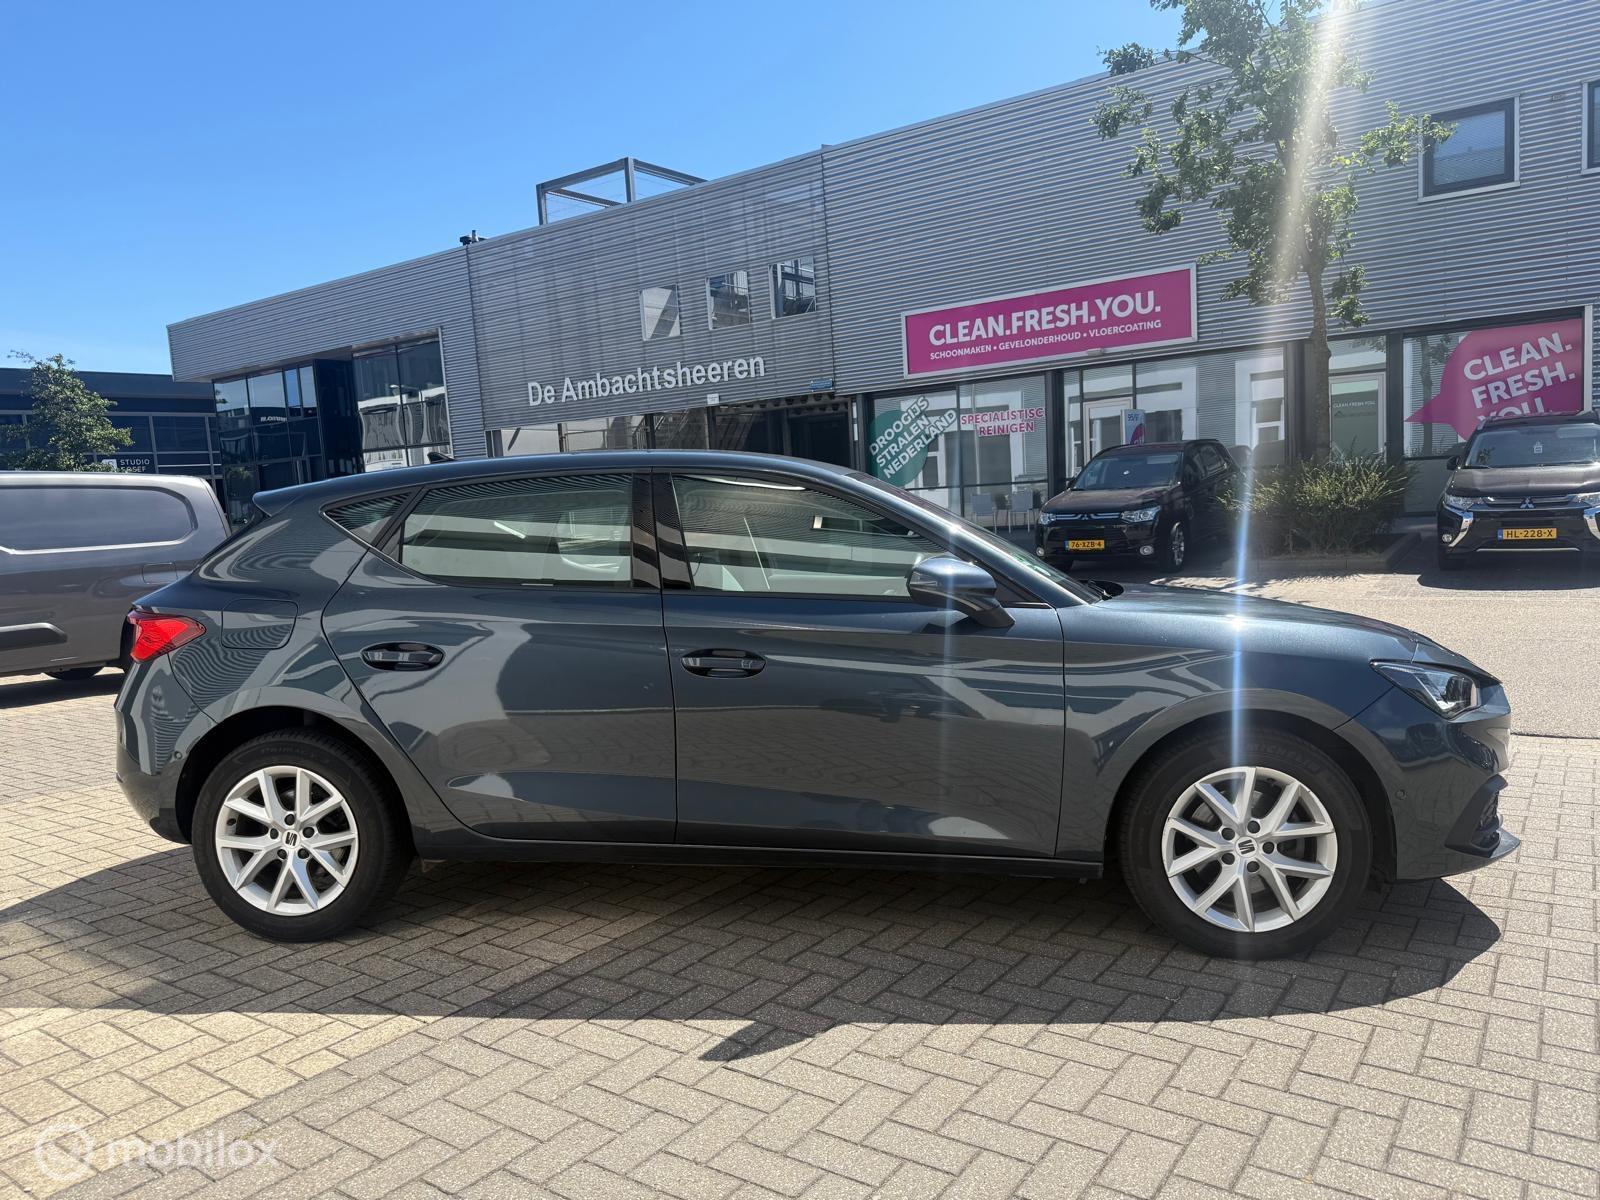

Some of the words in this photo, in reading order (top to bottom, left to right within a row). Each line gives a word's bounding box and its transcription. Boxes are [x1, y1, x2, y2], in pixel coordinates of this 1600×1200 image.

[929, 291, 1161, 346] CLEAN.FRESH.YOU.
[930, 344, 992, 360] SCHOONMAKEN
[998, 331, 1081, 350] GEVELONDERHOUD
[1089, 319, 1162, 338] VLOERCOATING
[1463, 332, 1573, 380] CLEAN.
[527, 382, 555, 406] De
[561, 356, 765, 403] Ambachtsheeren
[1471, 361, 1576, 409] FRESH.
[869, 396, 929, 455] DROOGIJS
[876, 414, 931, 467] STRALEN
[883, 409, 957, 479] NEDERLAND
[979, 421, 1035, 436] REINIGEN
[120, 458, 150, 466] STUDIO
[1506, 529, 1553, 538] HL-228-X
